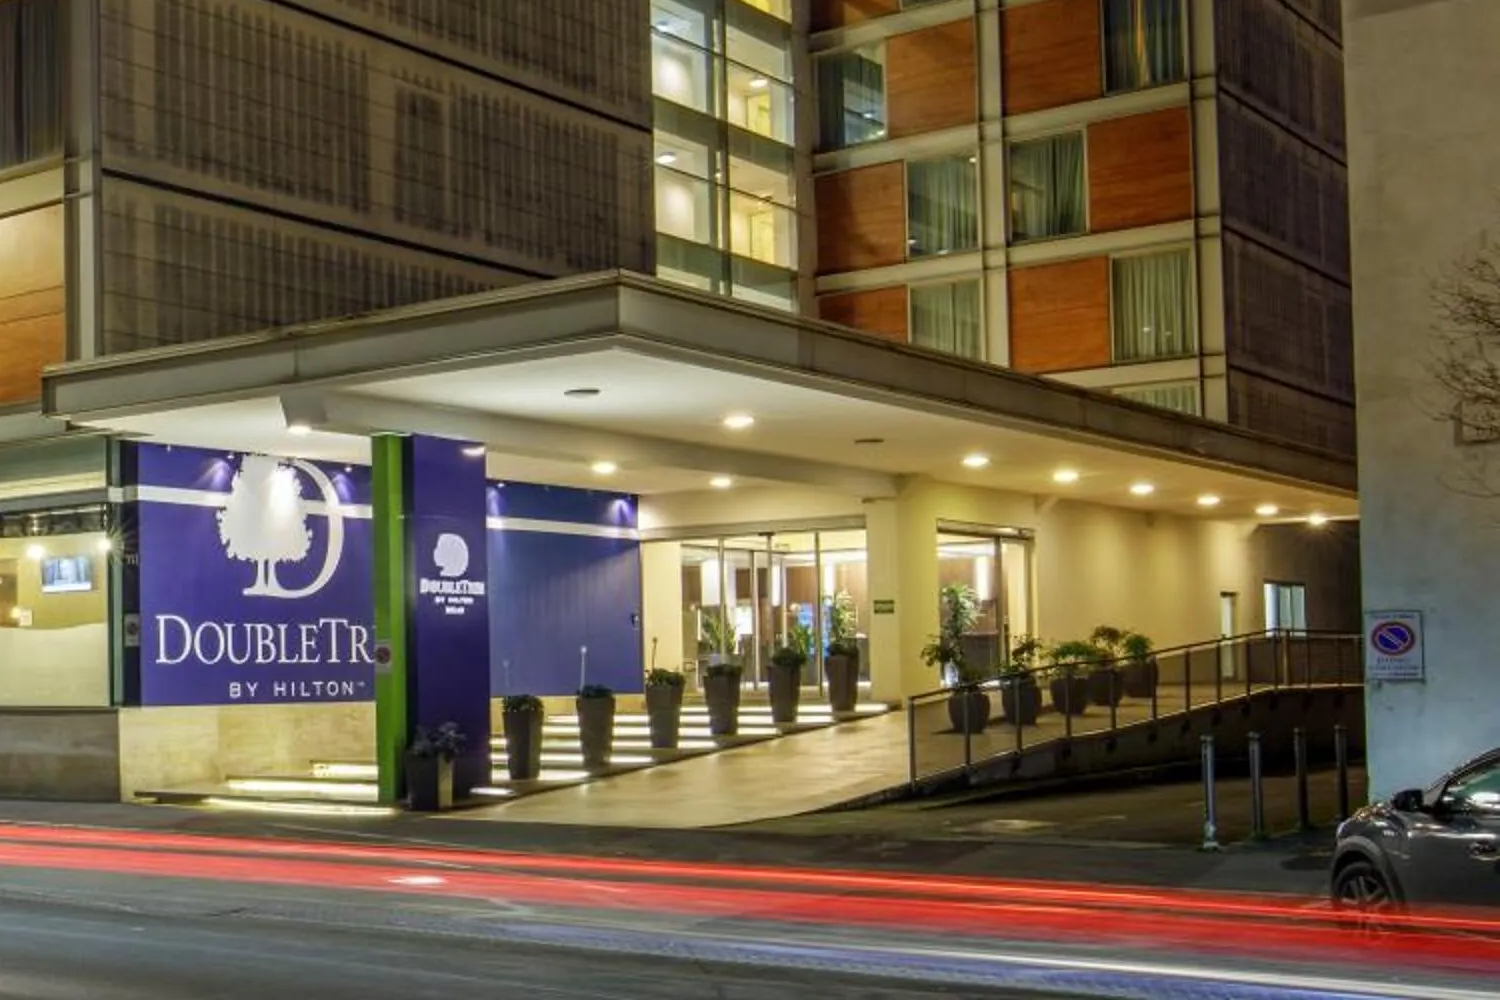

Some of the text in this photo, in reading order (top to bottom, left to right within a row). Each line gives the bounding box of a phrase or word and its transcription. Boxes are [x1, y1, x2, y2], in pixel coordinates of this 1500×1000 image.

[155, 614, 376, 665] DOUBLETR
[229, 681, 354, 698] BY HILTON
